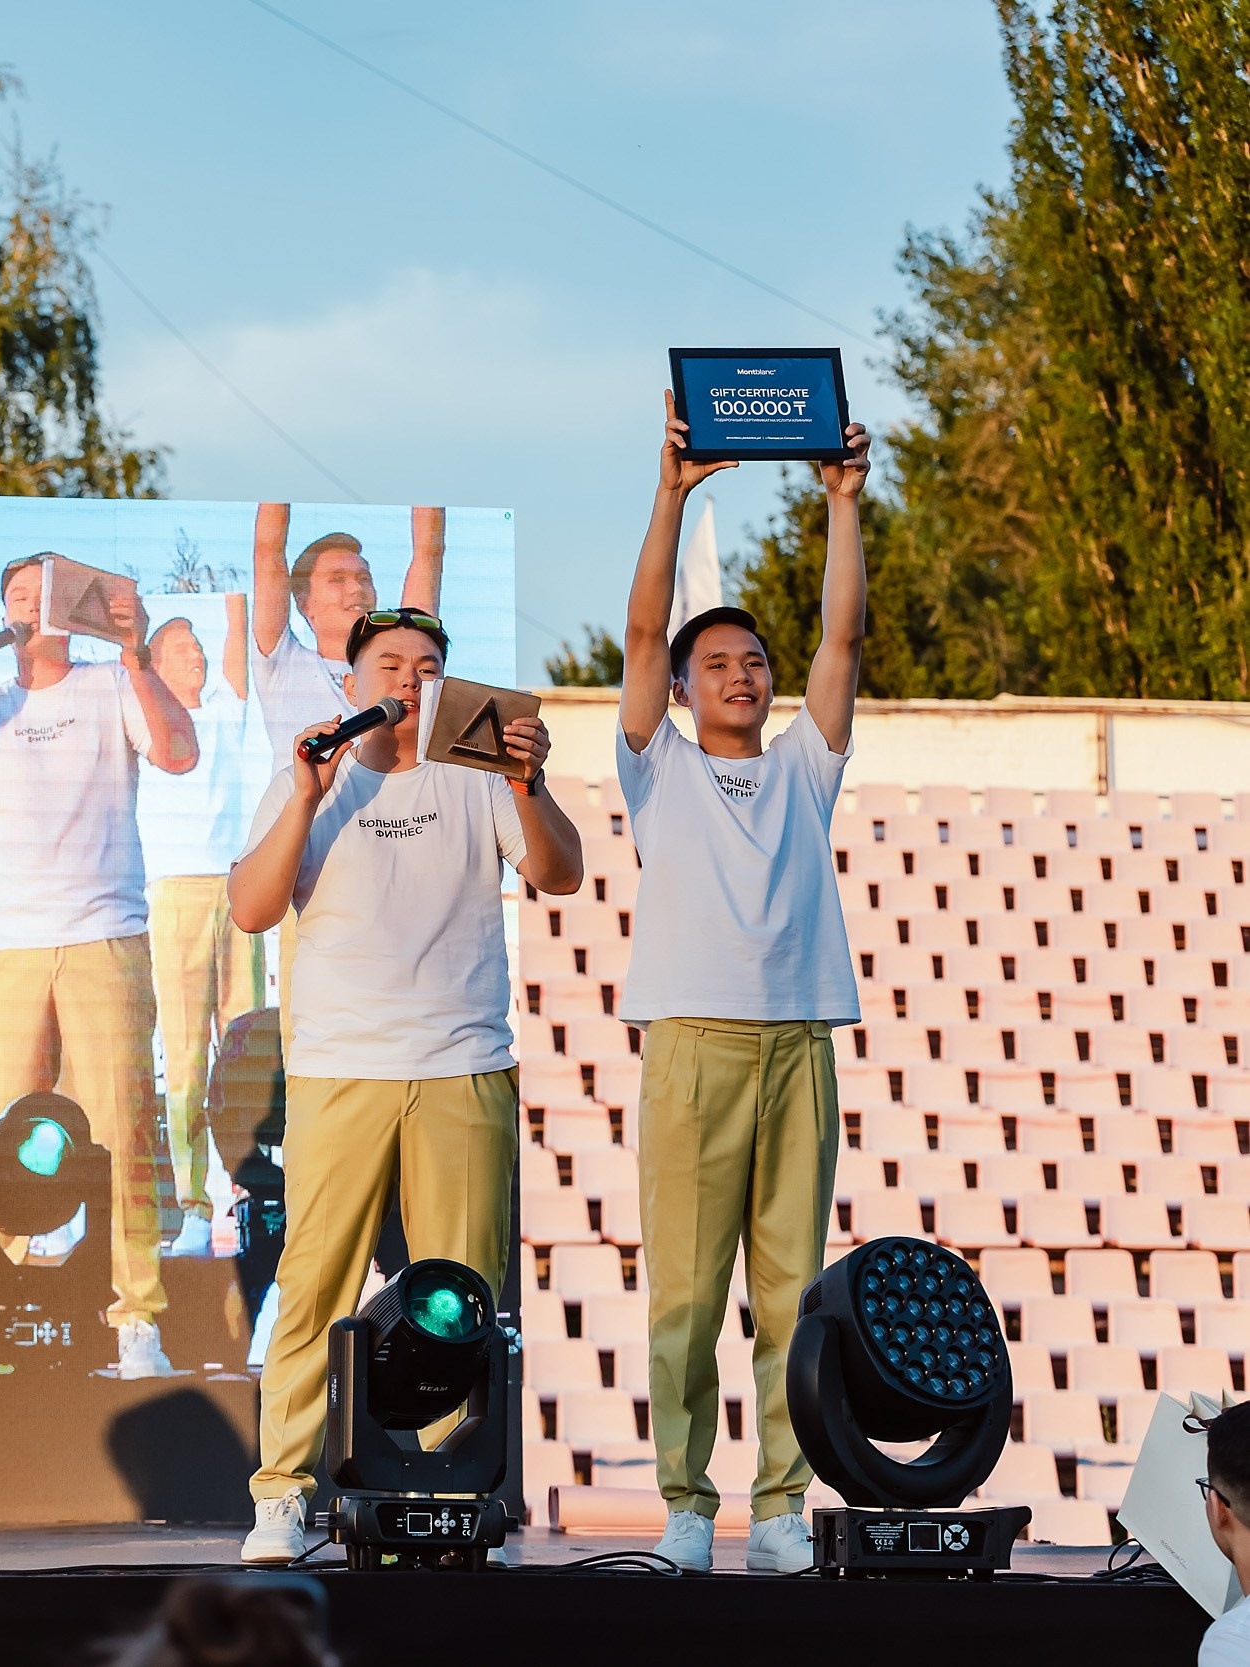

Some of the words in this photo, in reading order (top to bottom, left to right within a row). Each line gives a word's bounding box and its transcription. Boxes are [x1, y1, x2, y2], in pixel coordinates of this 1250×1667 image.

[710, 388, 736, 397] GIFT
[737, 388, 810, 398] CERTIFICATE
[711, 400, 792, 416] 100.000
[454, 738, 480, 749] ARRIVA
[715, 775, 752, 789] ОЛЬШЕ
[720, 786, 756, 797] ИТНЕ
[358, 818, 410, 829] БОЛЬШЕ
[412, 812, 438, 824] ЧЕМ
[375, 826, 423, 839] ФИТНЕС
